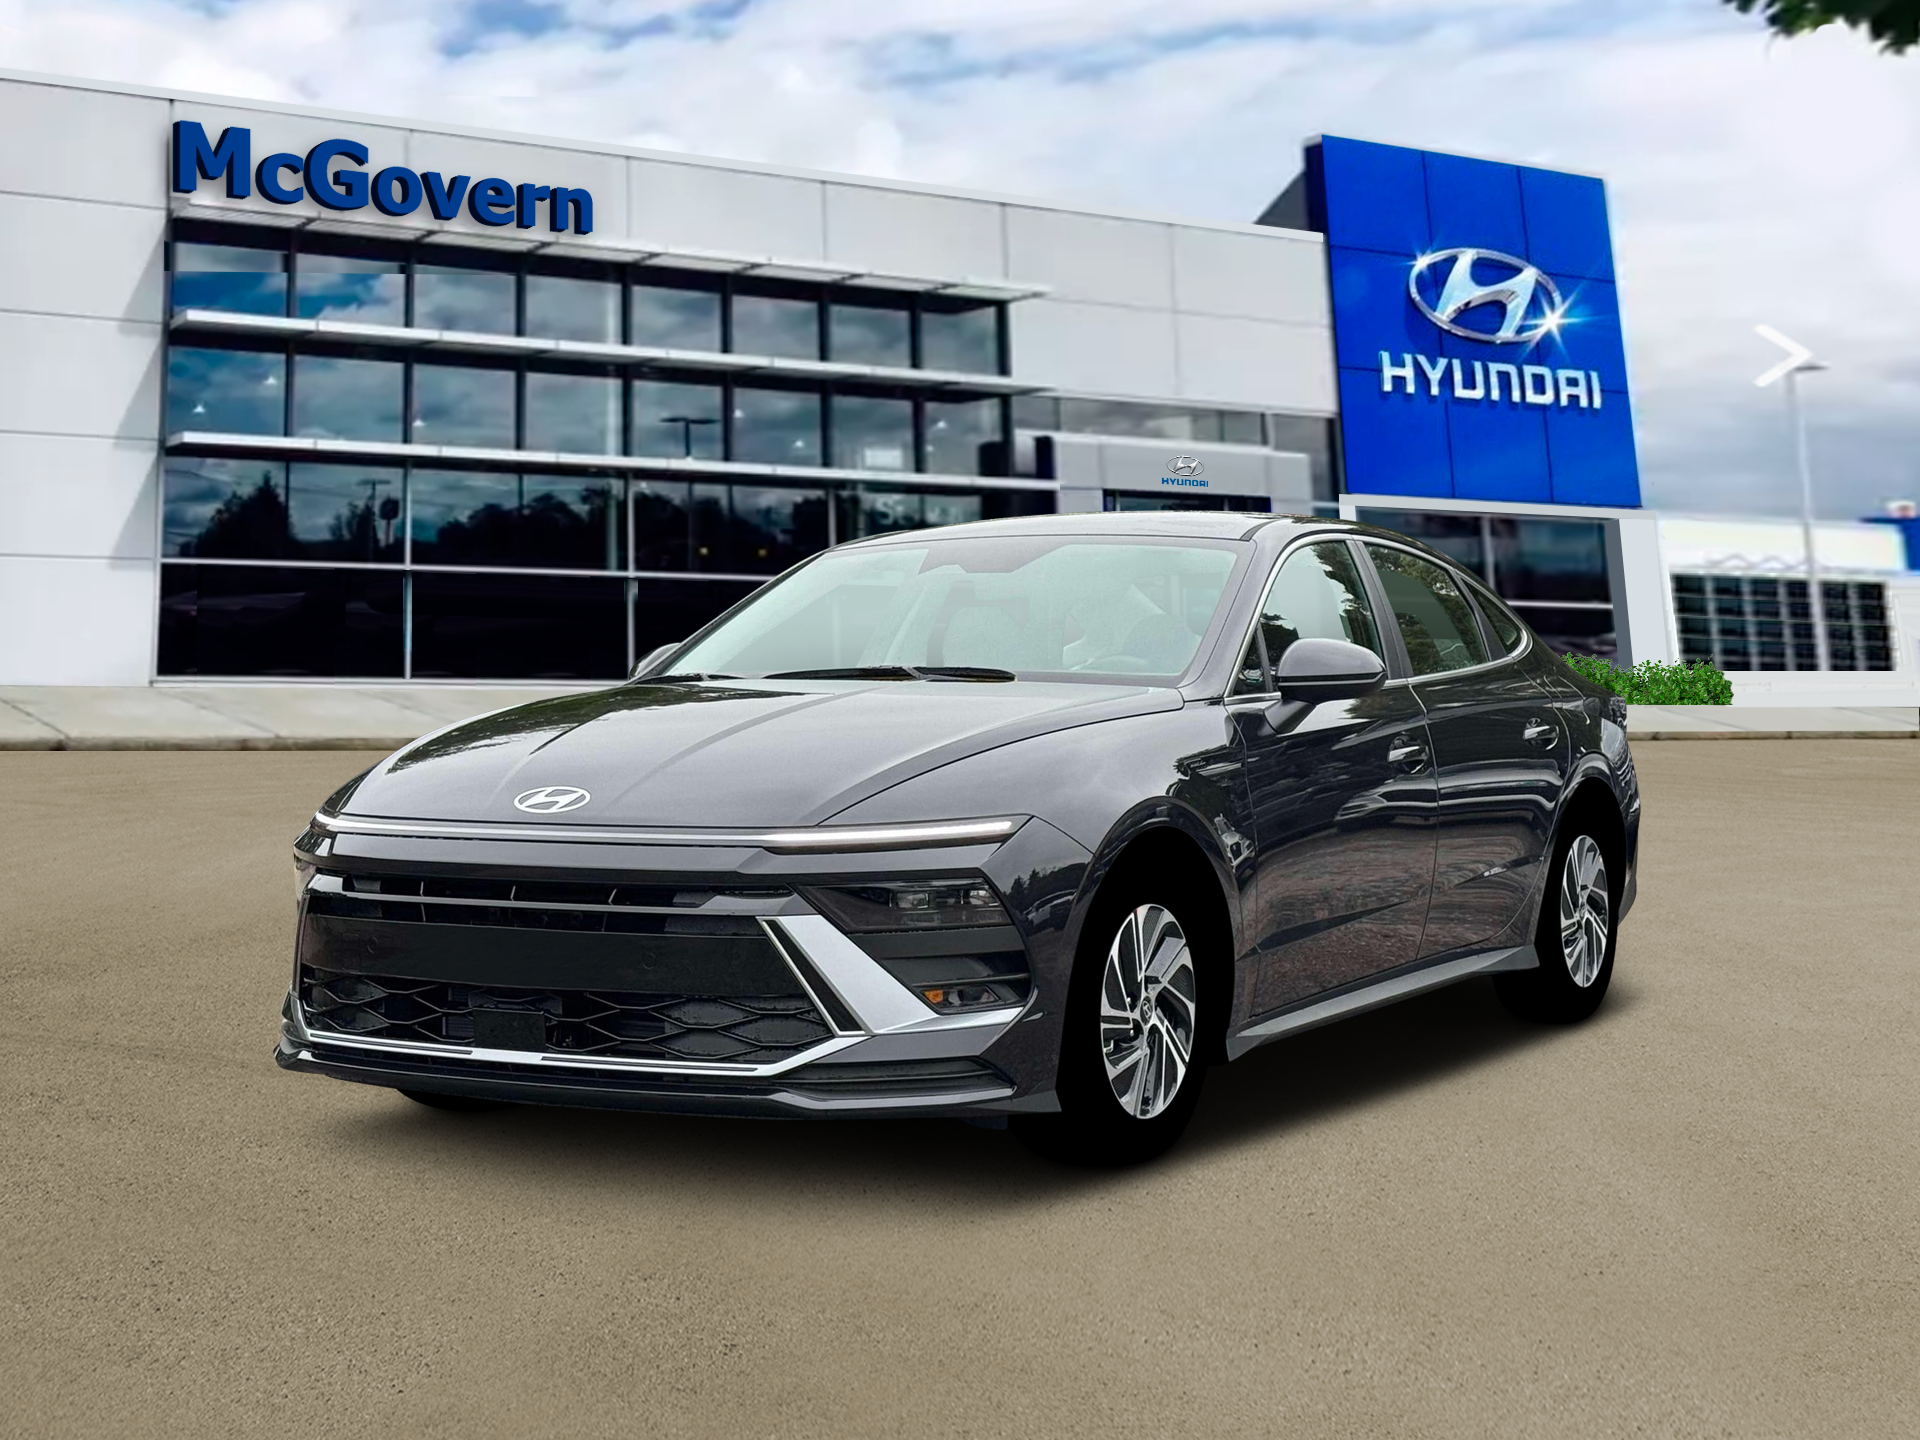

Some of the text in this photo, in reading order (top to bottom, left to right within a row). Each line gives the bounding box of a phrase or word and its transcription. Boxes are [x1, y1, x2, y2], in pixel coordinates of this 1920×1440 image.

[172, 120, 593, 234] McGovern
[1379, 351, 1602, 410] HYUNDAI
[1161, 477, 1209, 488] HYUNDAI
